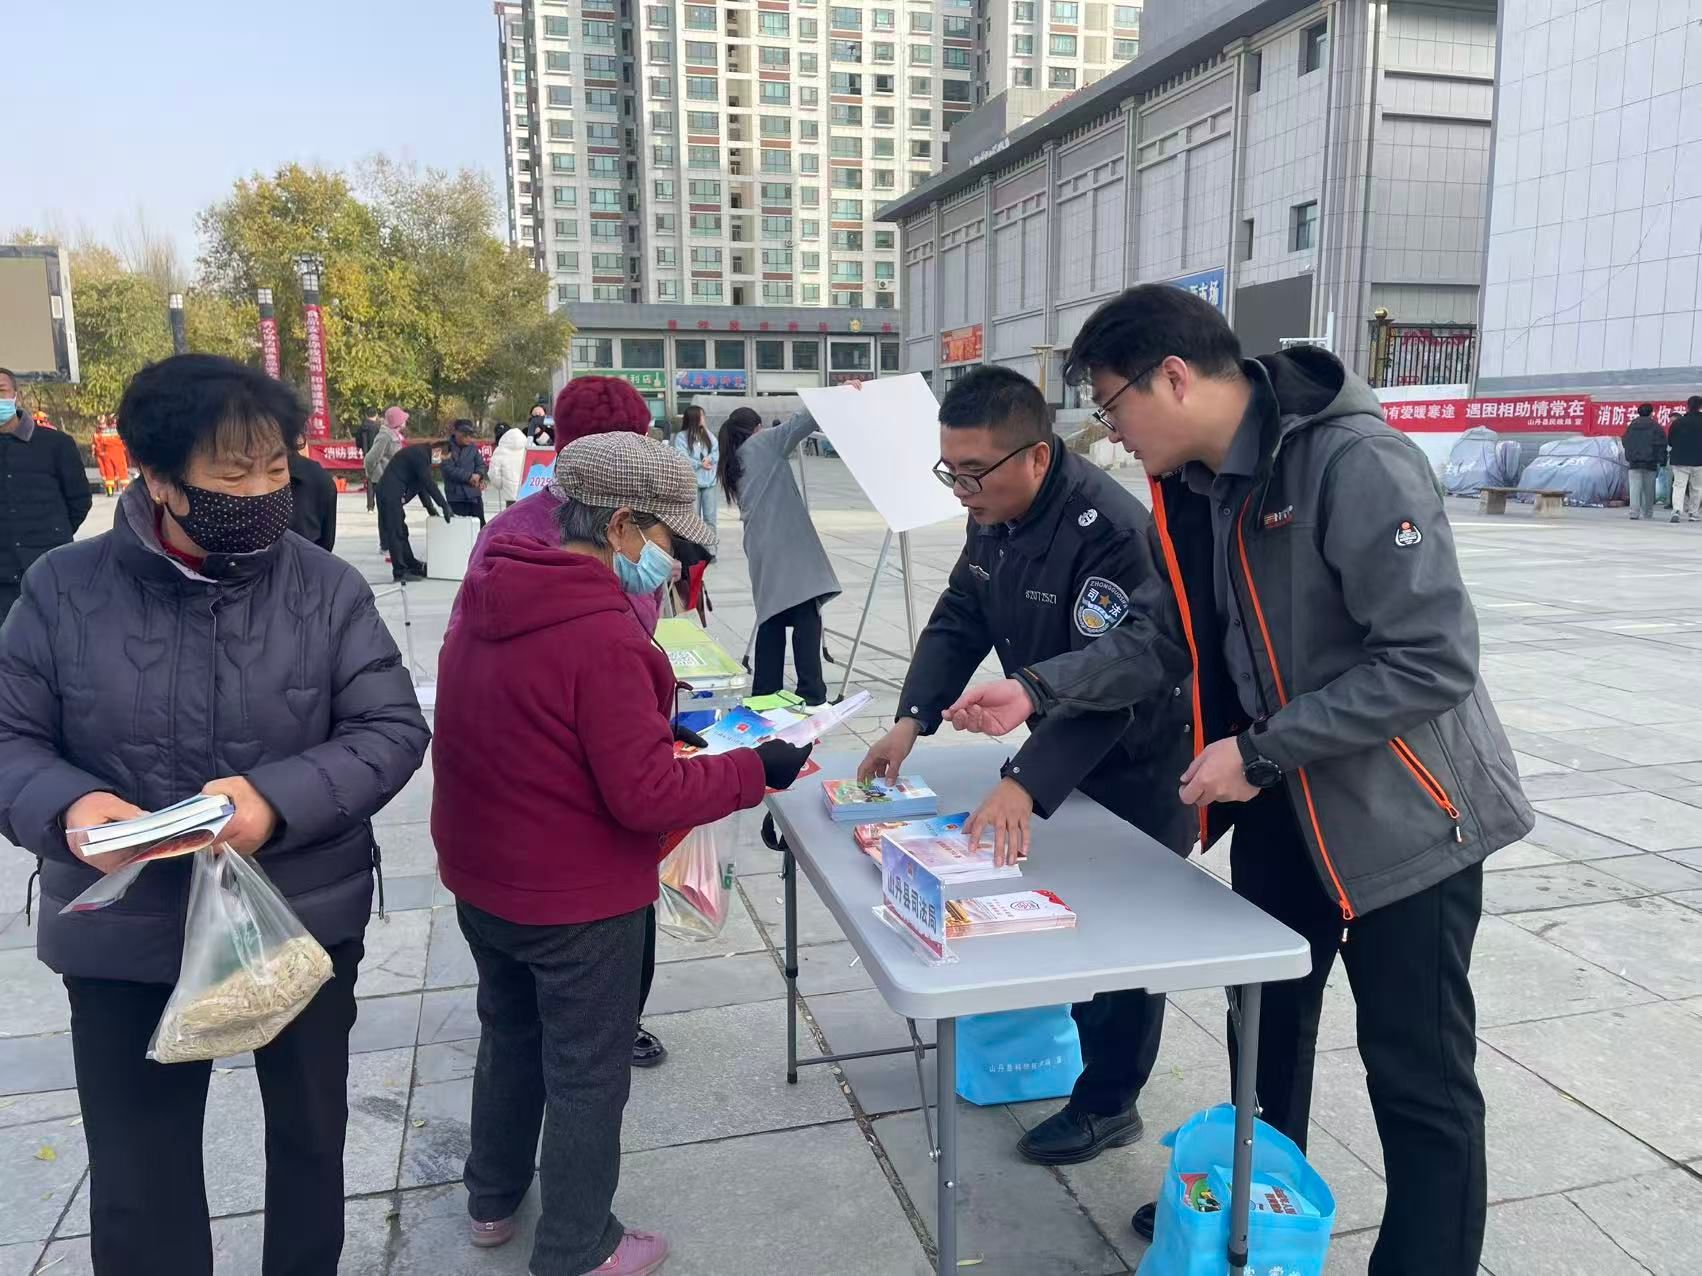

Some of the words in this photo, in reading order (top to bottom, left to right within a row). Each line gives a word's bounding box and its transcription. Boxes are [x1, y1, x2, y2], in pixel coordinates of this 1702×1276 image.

[1466, 400, 1585, 418] 遇困相助情常在
[887, 871, 937, 934] 山丹县司法局
